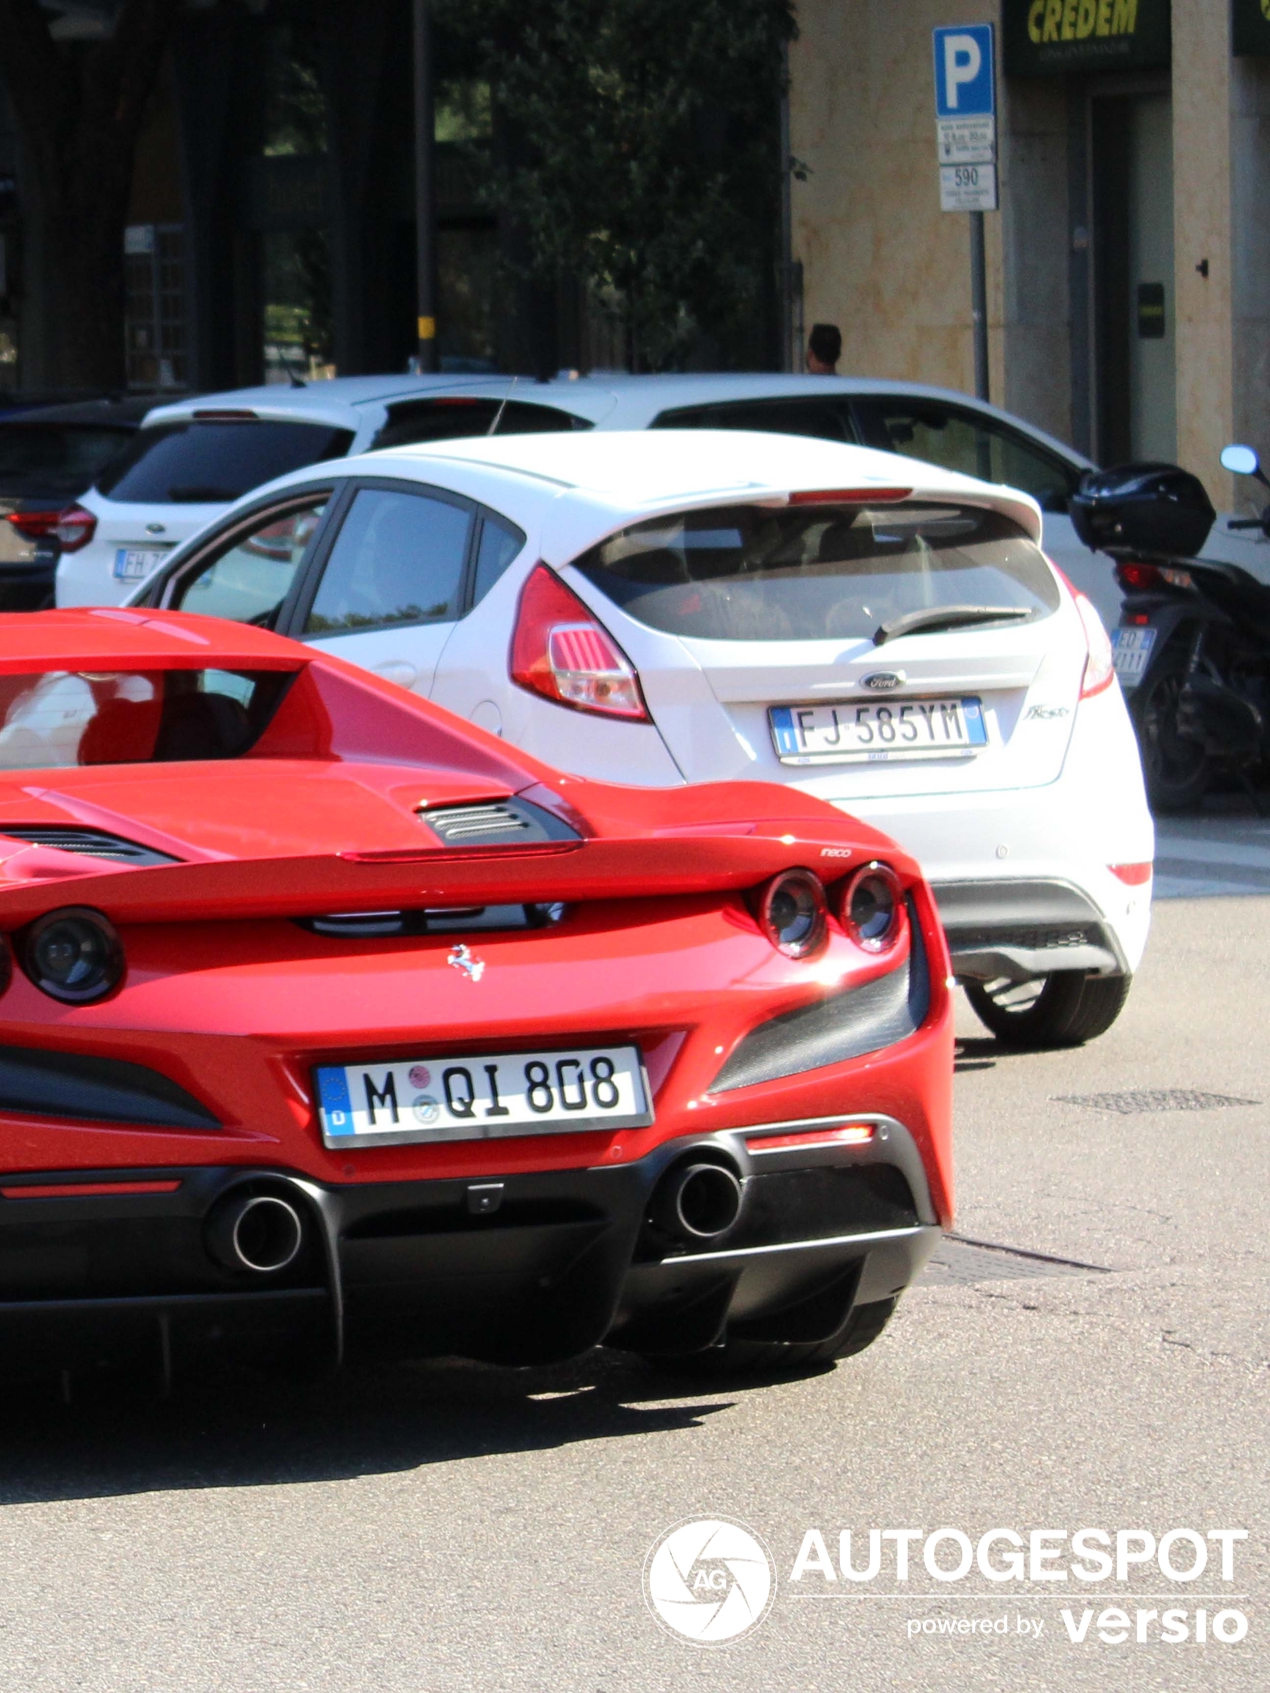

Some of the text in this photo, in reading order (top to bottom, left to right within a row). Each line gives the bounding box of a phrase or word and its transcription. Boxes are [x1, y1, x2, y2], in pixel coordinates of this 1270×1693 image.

[1027, 0, 1138, 44] CREDEM
[944, 34, 981, 108] P
[955, 167, 978, 187] 590
[870, 678, 897, 688] Ford
[797, 702, 963, 747] FJ 585YM
[363, 1056, 620, 1125] M QI 808
[332, 1110, 346, 1125] D
